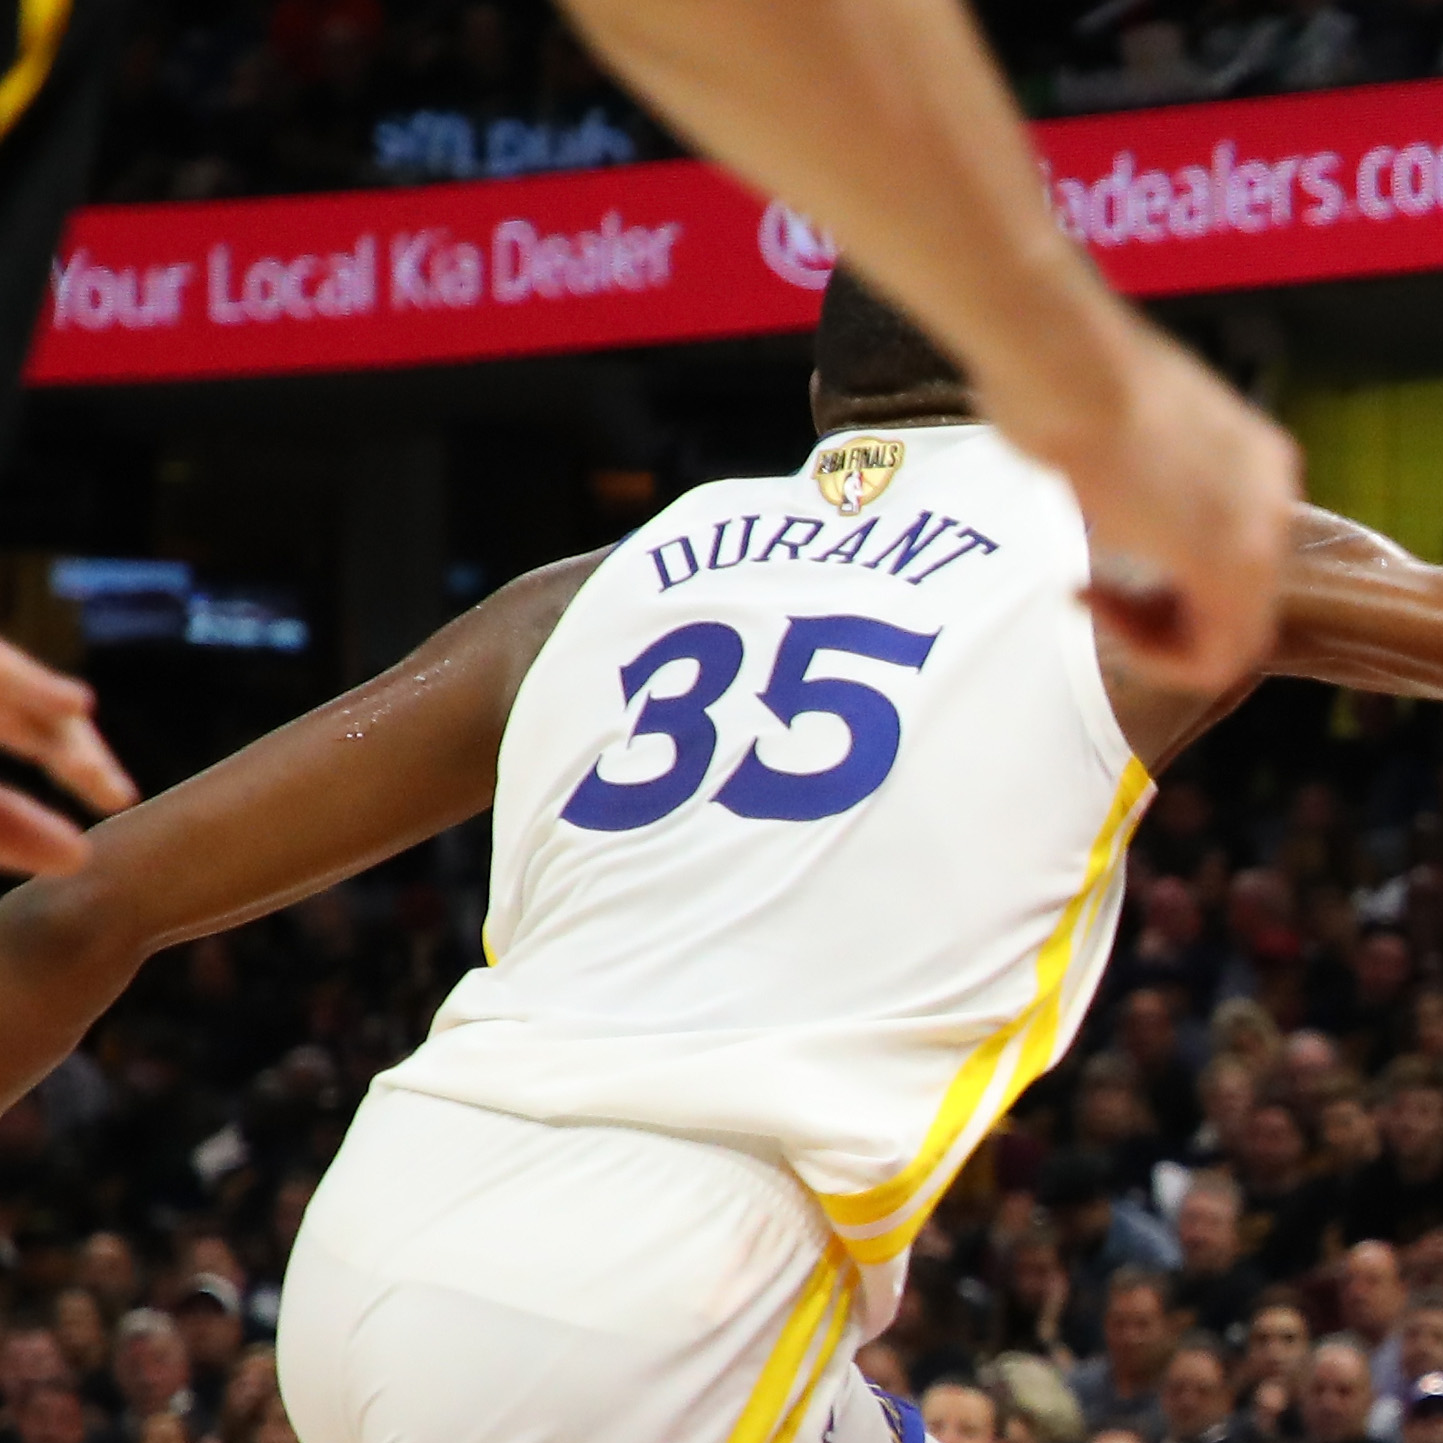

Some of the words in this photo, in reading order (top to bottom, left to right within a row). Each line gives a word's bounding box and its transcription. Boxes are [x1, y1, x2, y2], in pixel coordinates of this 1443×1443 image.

[53, 246, 194, 332] Your
[207, 236, 378, 325] Local
[391, 230, 485, 309] Kia
[492, 209, 683, 304] Dealer
[848, 443, 900, 470] FINALS
[646, 509, 1001, 593] DURANT
[558, 613, 944, 832] 35
